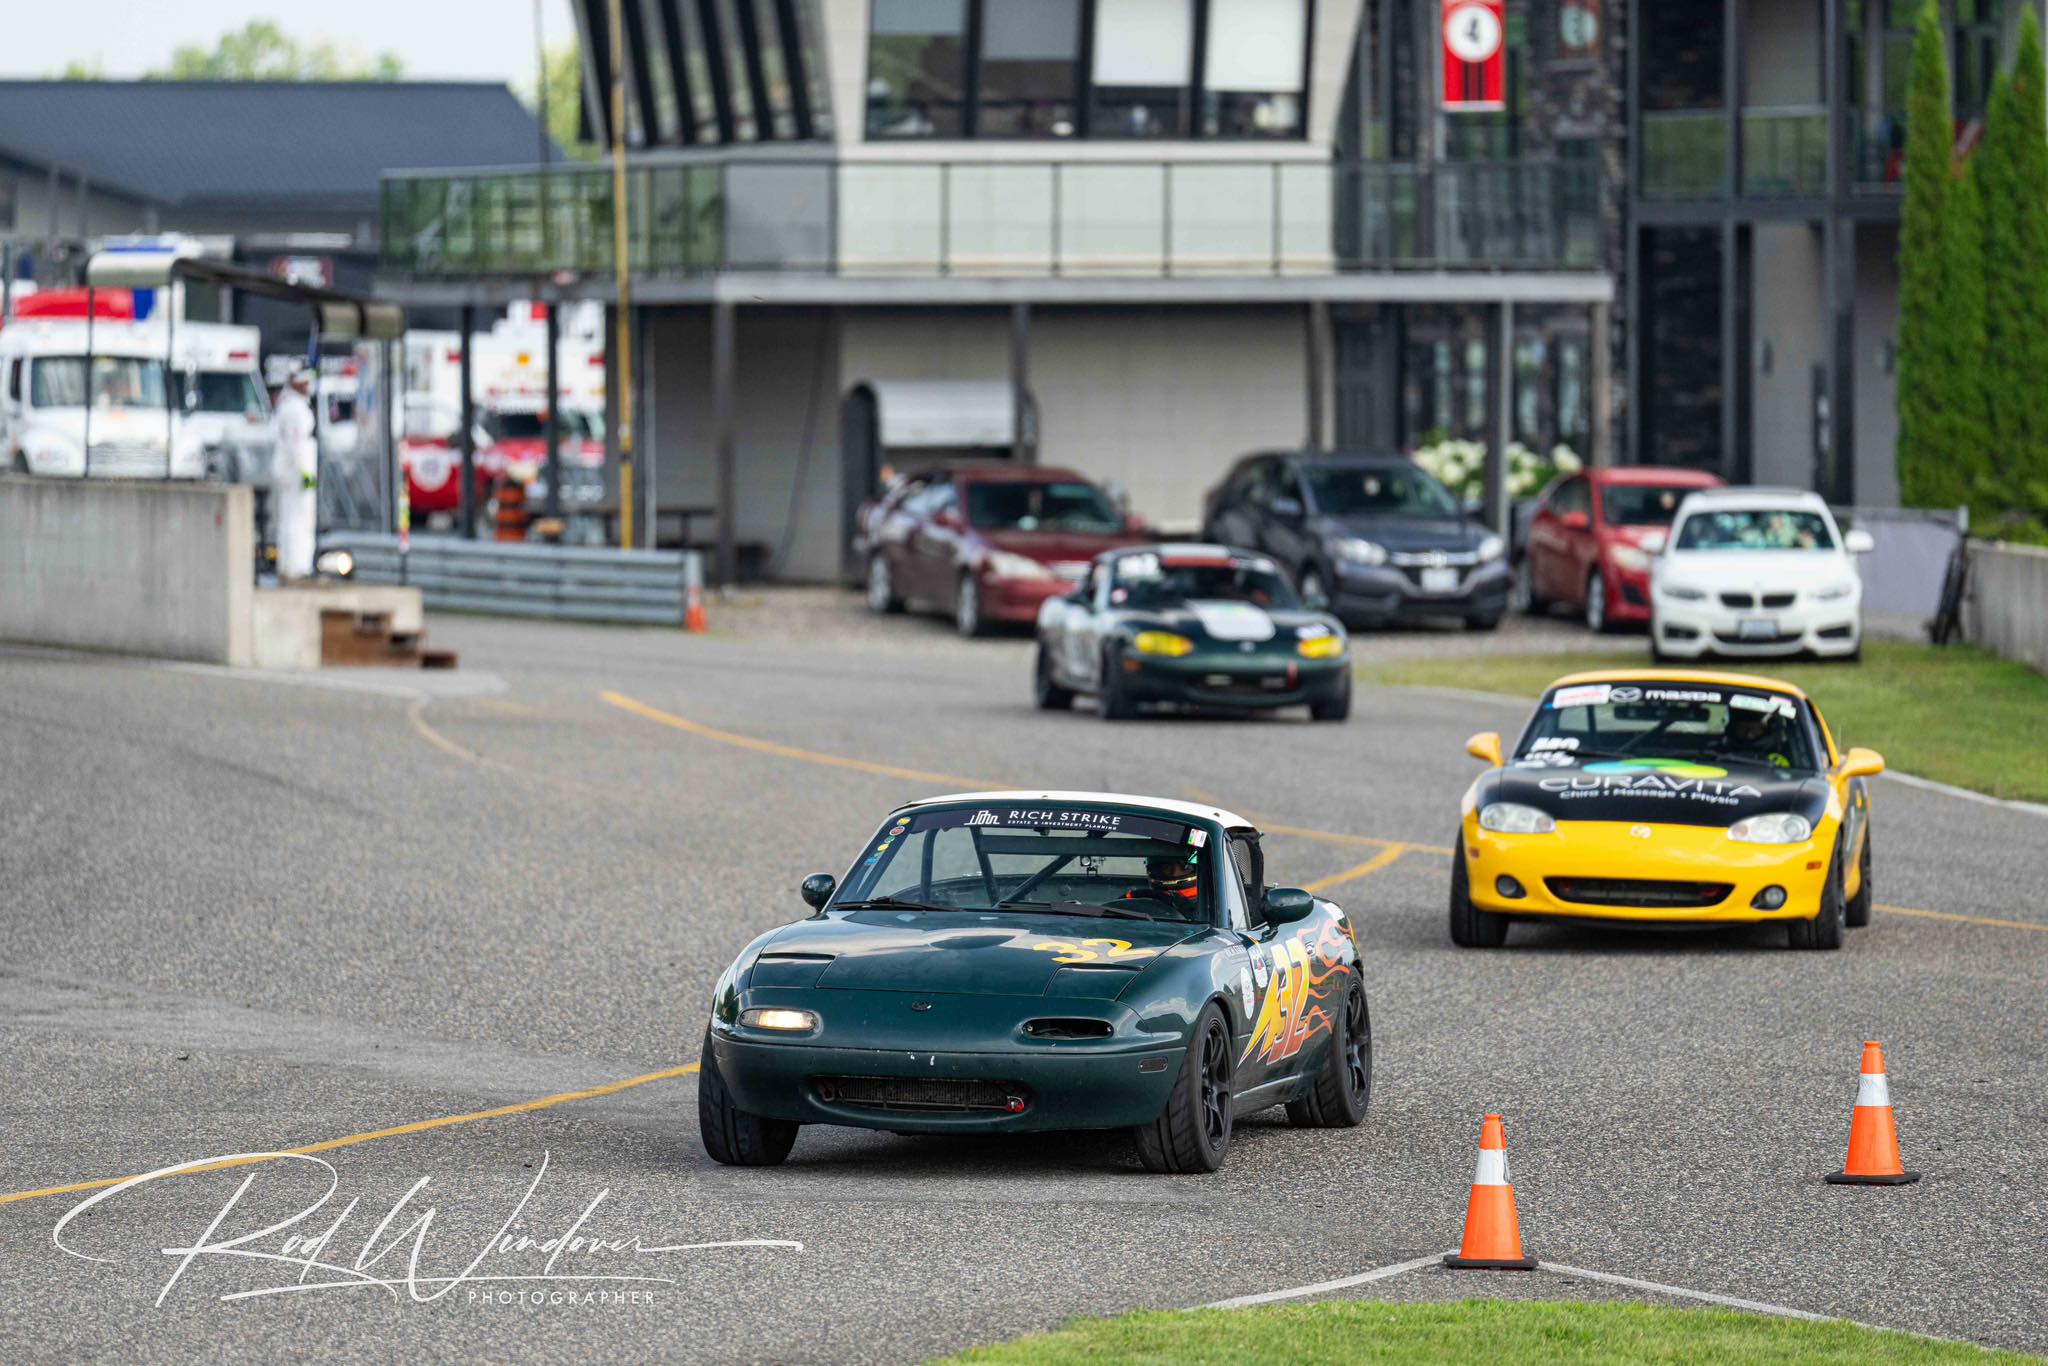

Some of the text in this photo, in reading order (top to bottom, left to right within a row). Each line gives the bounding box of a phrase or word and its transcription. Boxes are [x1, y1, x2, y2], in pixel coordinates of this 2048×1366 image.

[1645, 689, 1722, 703] mazda
[1539, 775, 1762, 798] CURAVITA
[1559, 789, 1600, 800] Chiro
[1009, 810, 1121, 825] RICH STRIKE
[1033, 938, 1155, 964] 32
[1240, 937, 1310, 1067] 32
